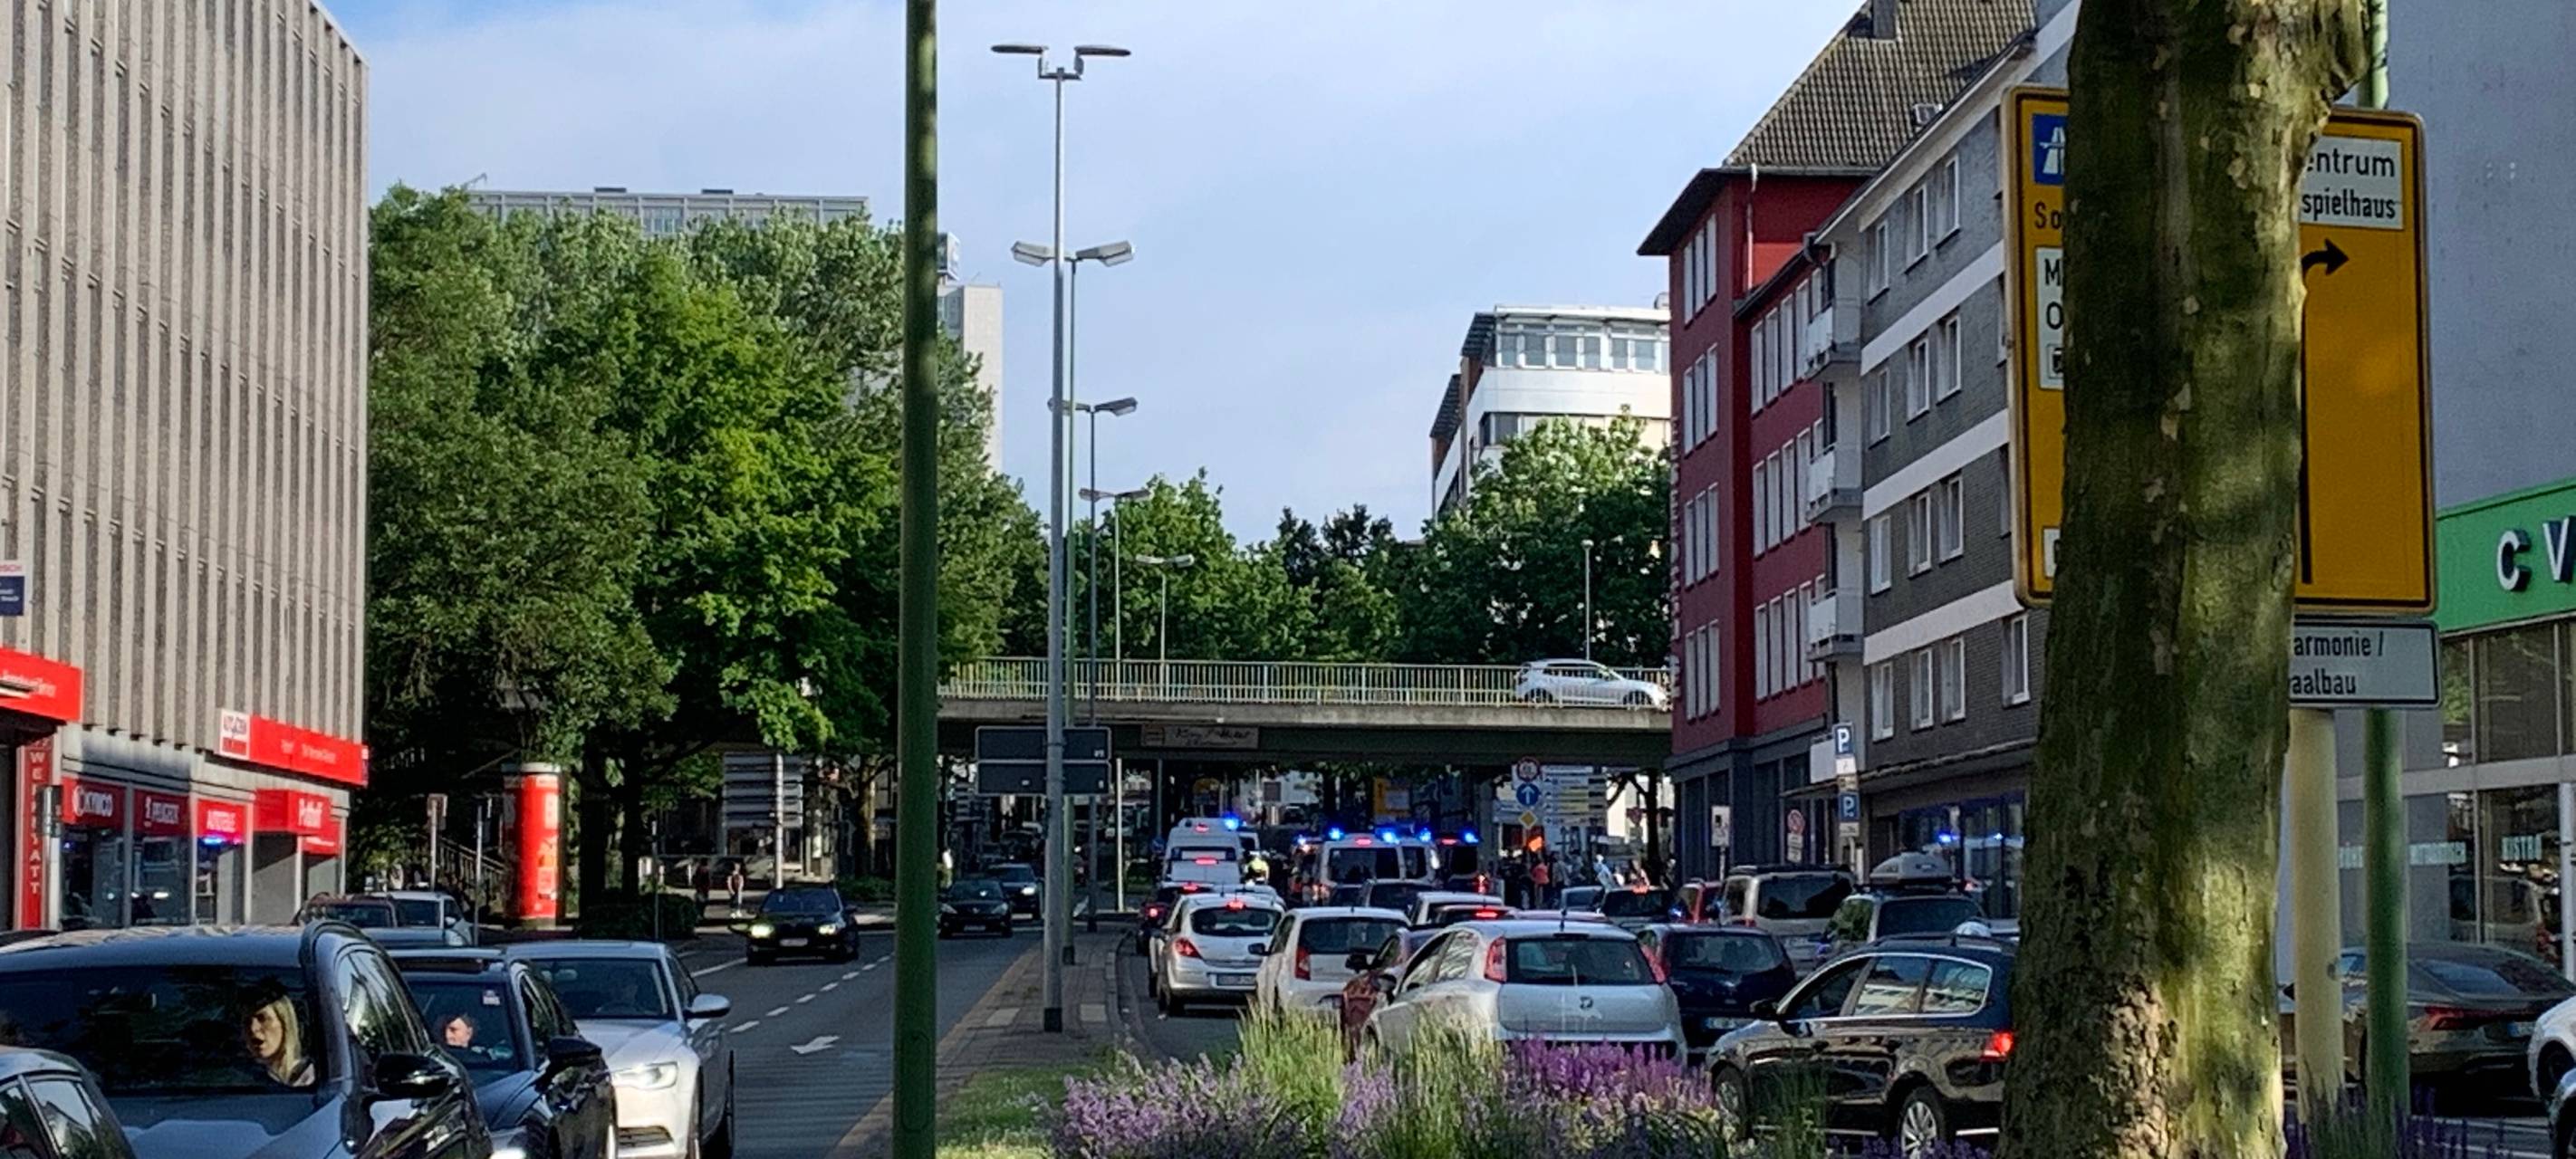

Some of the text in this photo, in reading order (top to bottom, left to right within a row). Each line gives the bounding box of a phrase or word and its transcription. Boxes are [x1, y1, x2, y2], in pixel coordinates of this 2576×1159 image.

[2034, 201, 2062, 229] So
[2302, 187, 2396, 221] spielhaus
[2293, 630, 2372, 656] armonie
[2292, 668, 2357, 694] aalbau
